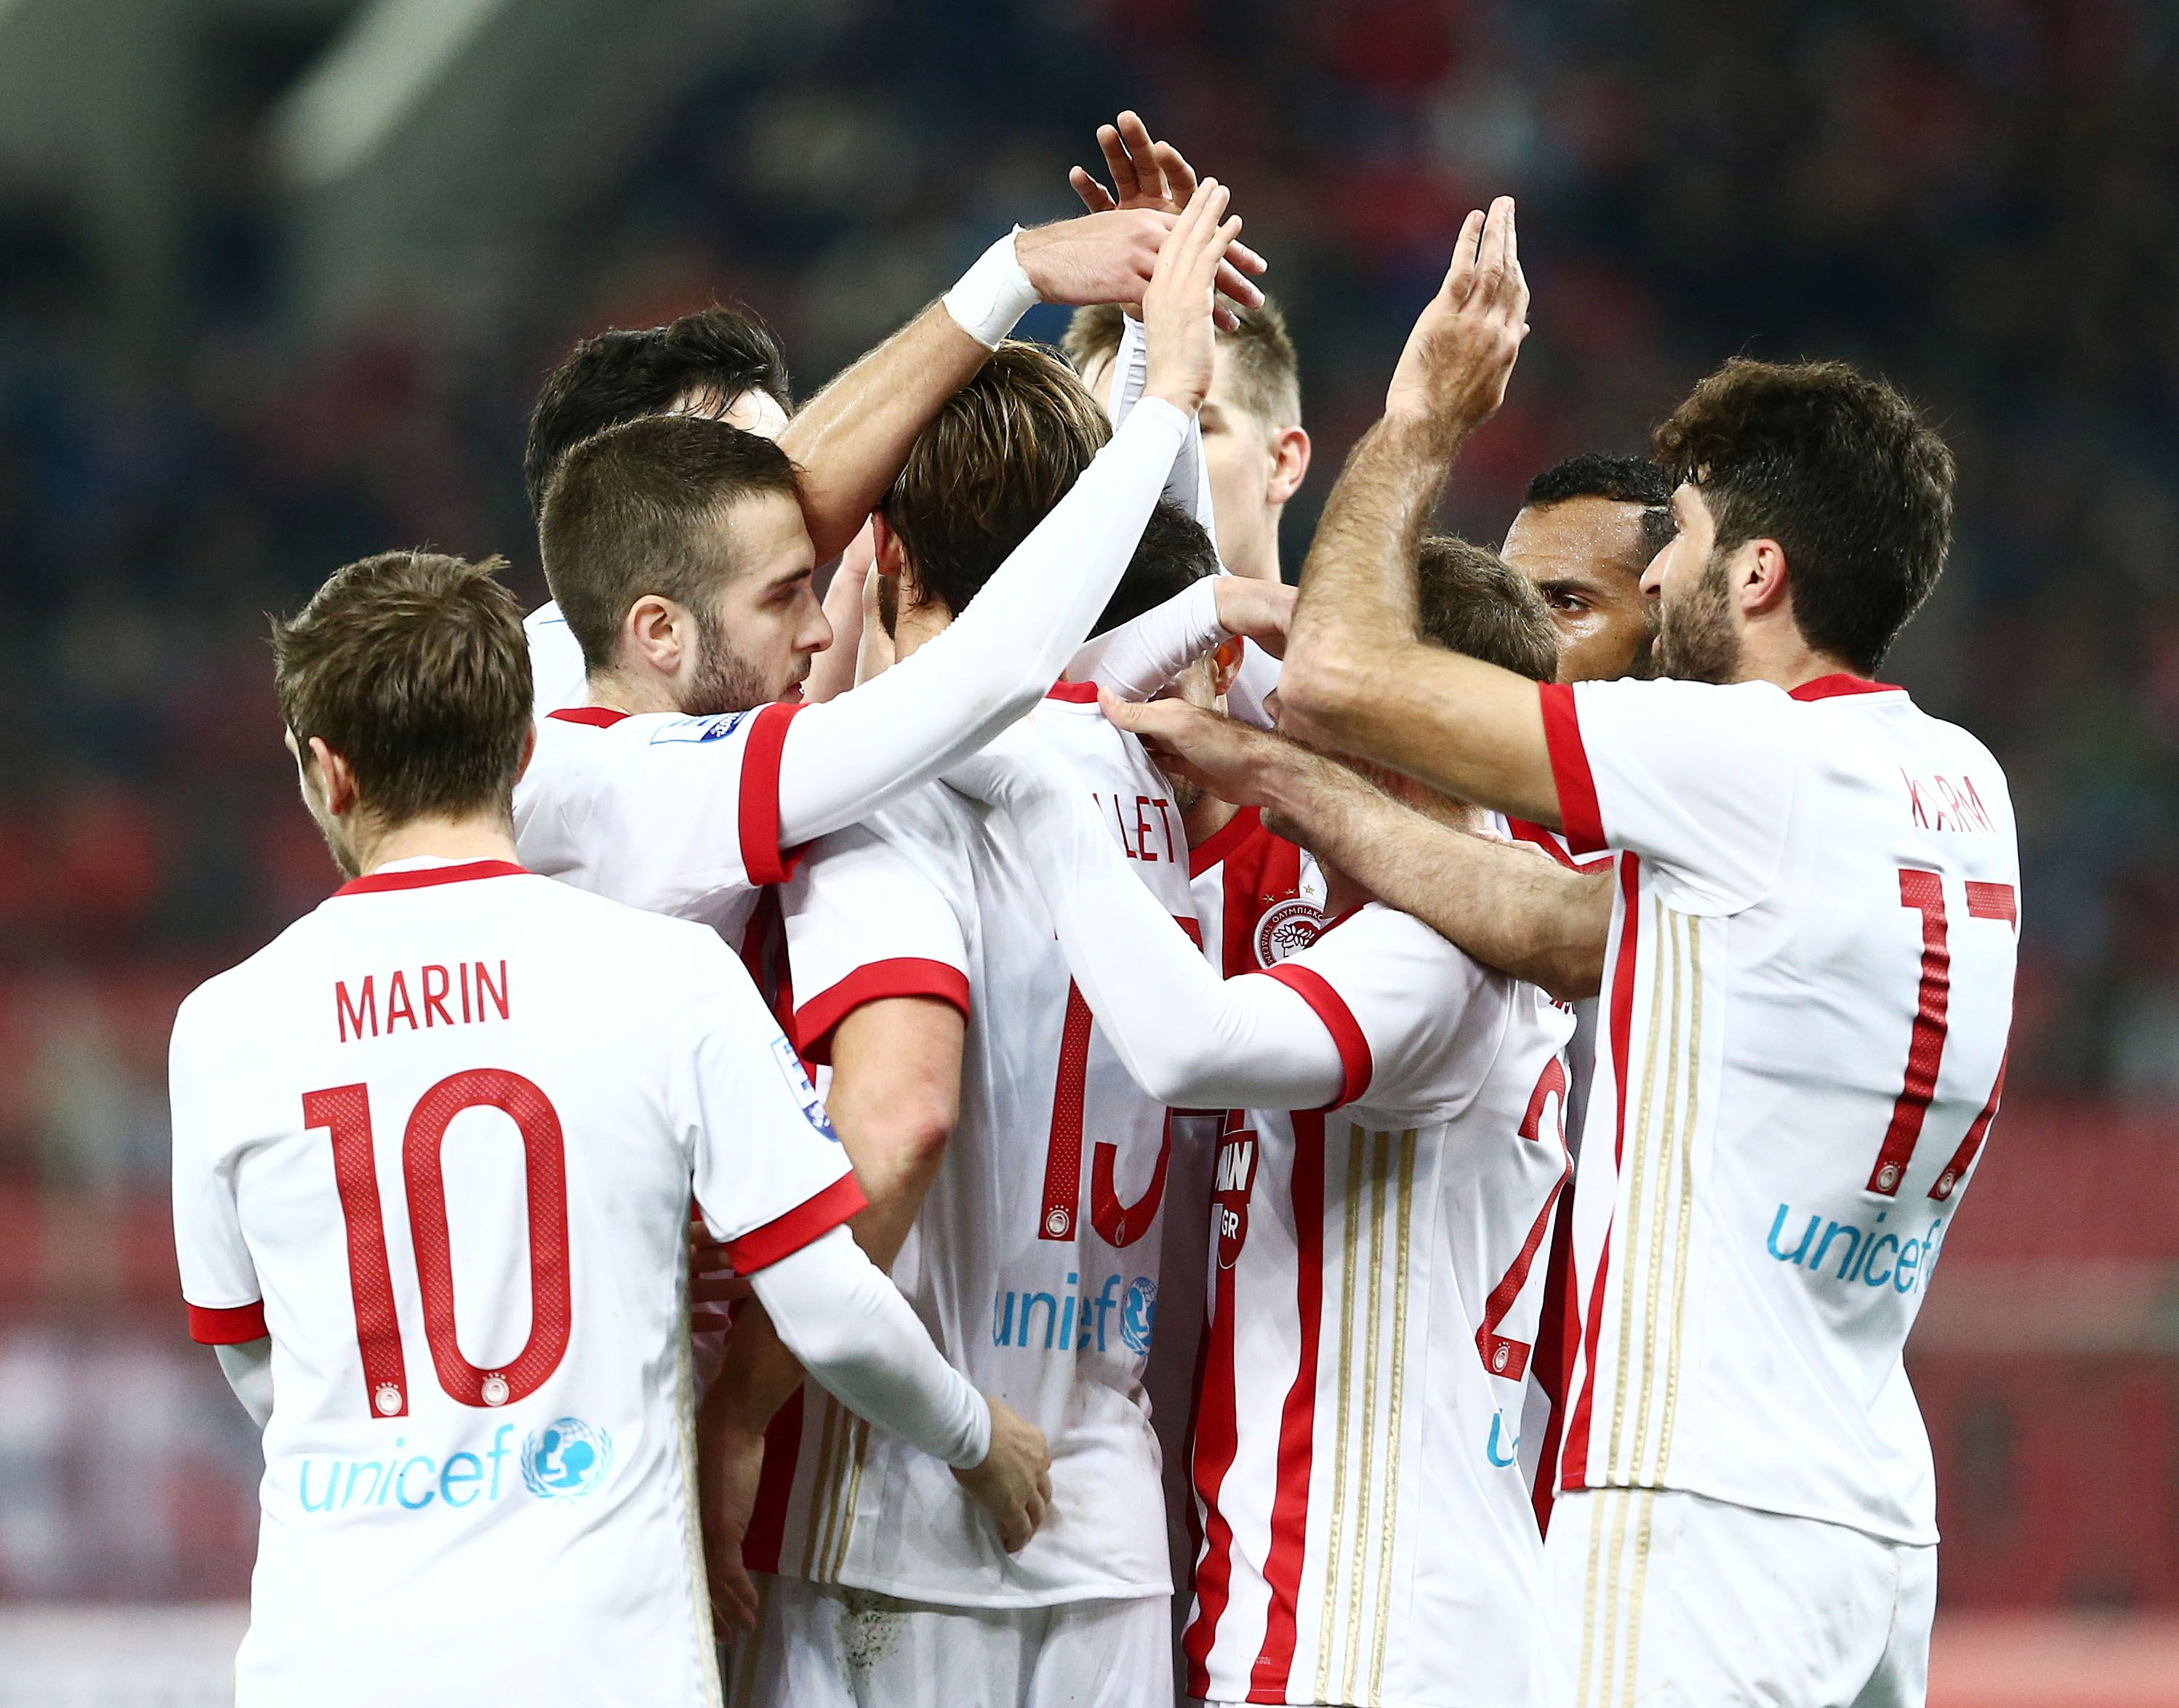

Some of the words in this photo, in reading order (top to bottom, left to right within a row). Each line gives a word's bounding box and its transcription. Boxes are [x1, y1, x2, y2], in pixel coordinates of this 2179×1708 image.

[1092, 793, 1174, 863] LET
[334, 960, 510, 1043] MARIN
[1866, 868, 2016, 1202] 17
[302, 1067, 572, 1419] 10
[1767, 1203, 1942, 1294] unicef
[300, 1423, 514, 1513] unicef
